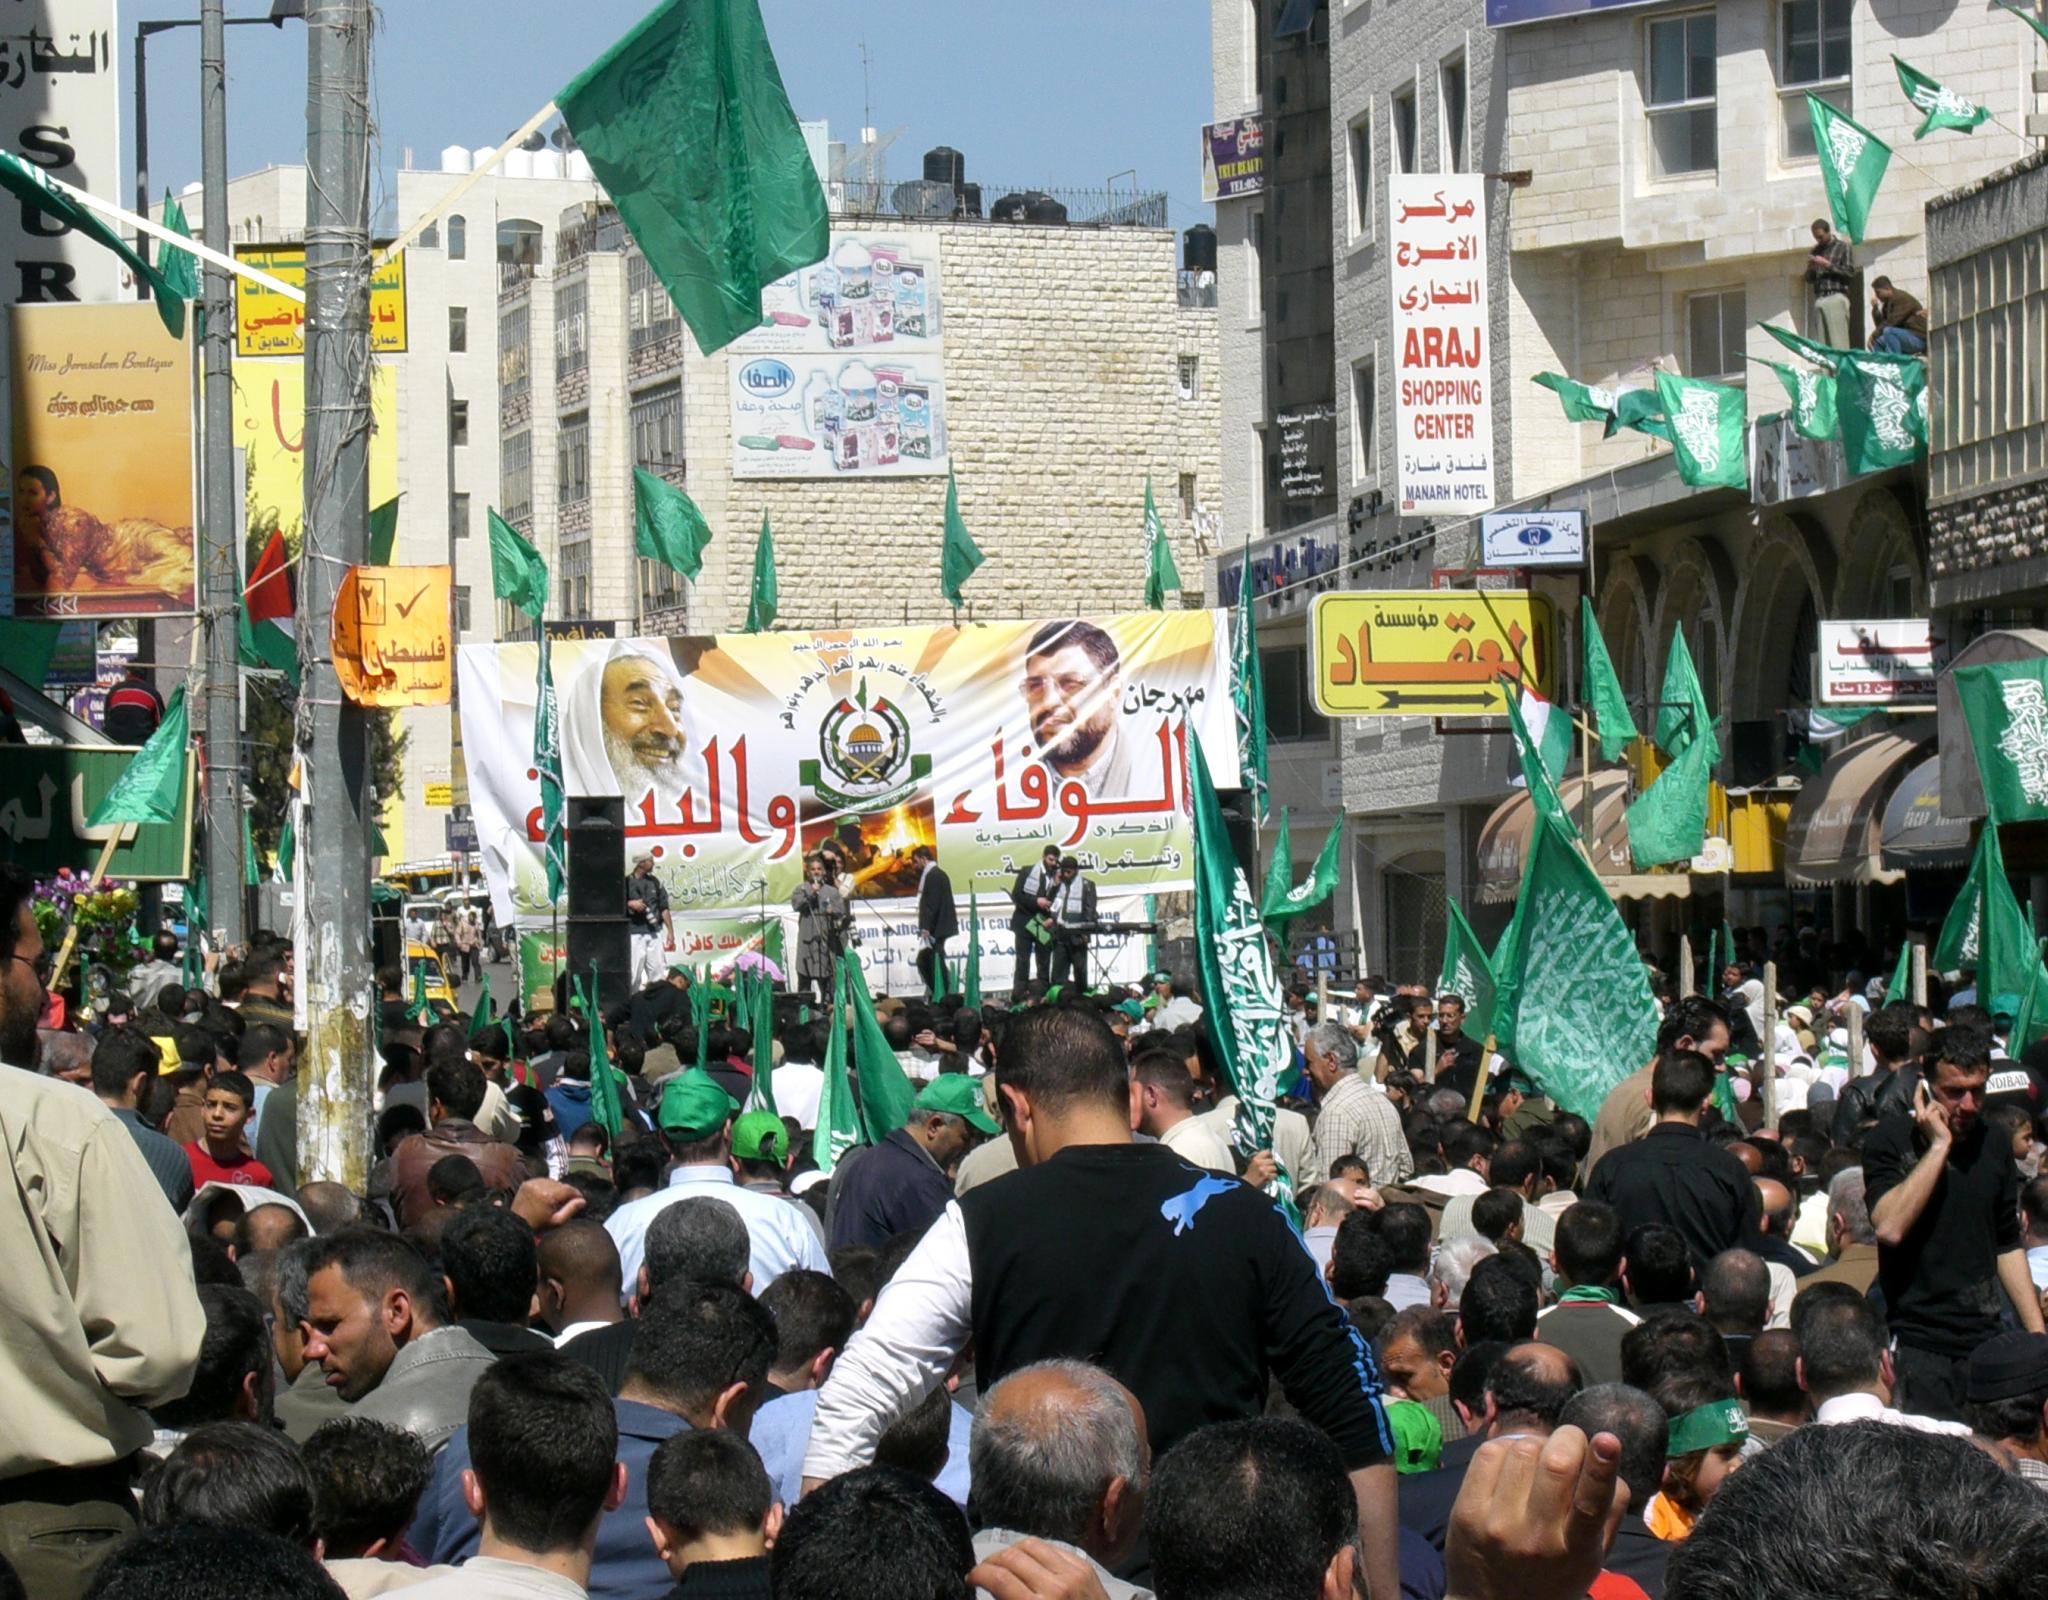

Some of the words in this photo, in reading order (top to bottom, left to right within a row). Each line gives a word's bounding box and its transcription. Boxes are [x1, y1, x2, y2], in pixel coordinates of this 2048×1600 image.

[1397, 190, 1475, 224] مركز
[1397, 234, 1477, 268] الاعرج
[1398, 279, 1480, 316] التجاري
[1402, 326, 1481, 369] ARAJ
[27, 353, 57, 372] Miss
[58, 352, 119, 375] Jerusalem
[122, 351, 174, 373] Boutique
[747, 368, 788, 388] الصفا
[1401, 379, 1482, 407] SHOPPING
[1414, 413, 1475, 440] CENTER
[1404, 455, 1441, 475] منارة
[1446, 454, 1488, 475] فندق
[1405, 484, 1451, 502] MANARH
[1454, 484, 1489, 500] HOTEL
[1374, 605, 1439, 631] مؤسسة
[1121, 682, 1206, 715] مهرجان
[1857, 683, 1871, 693] 12
